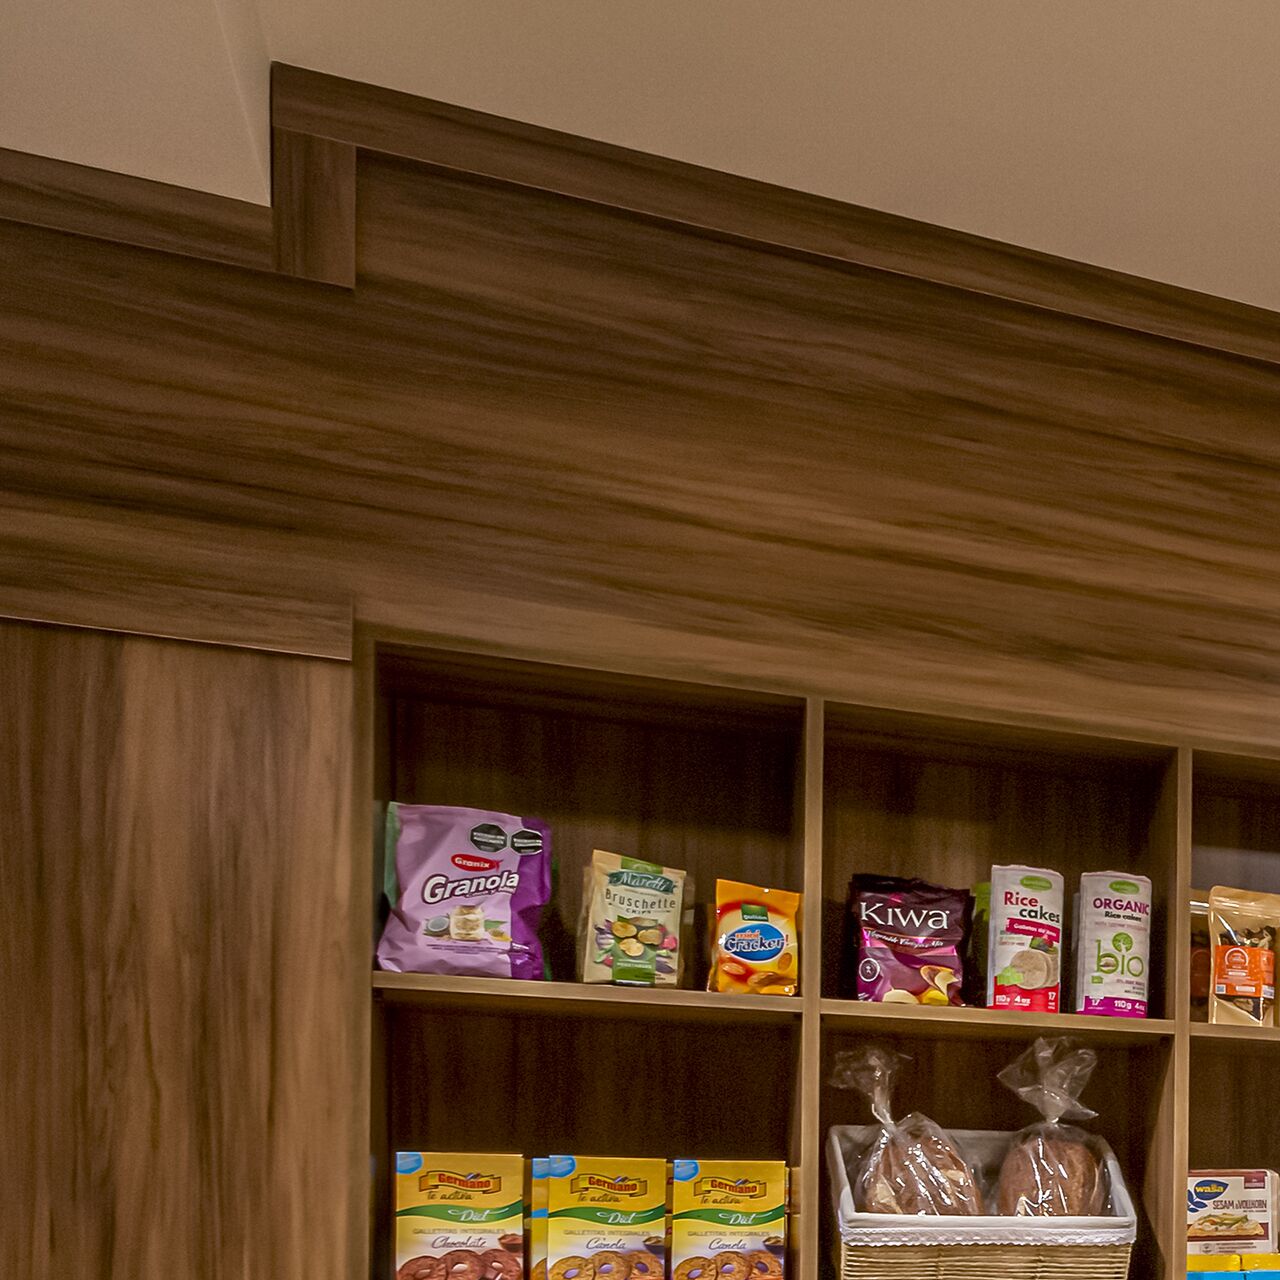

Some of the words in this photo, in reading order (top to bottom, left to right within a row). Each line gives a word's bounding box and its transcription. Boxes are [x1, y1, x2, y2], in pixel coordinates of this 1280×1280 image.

[423, 871, 519, 904] Granola
[605, 888, 677, 909] Bruschette
[1004, 891, 1039, 907] Rice
[1092, 897, 1150, 916] ORGANIC
[860, 902, 949, 929] Kiwa
[1019, 905, 1060, 924] cakes
[438, 1173, 490, 1190] Germano
[588, 1176, 637, 1192] Germano
[711, 1179, 757, 1194] Germano
